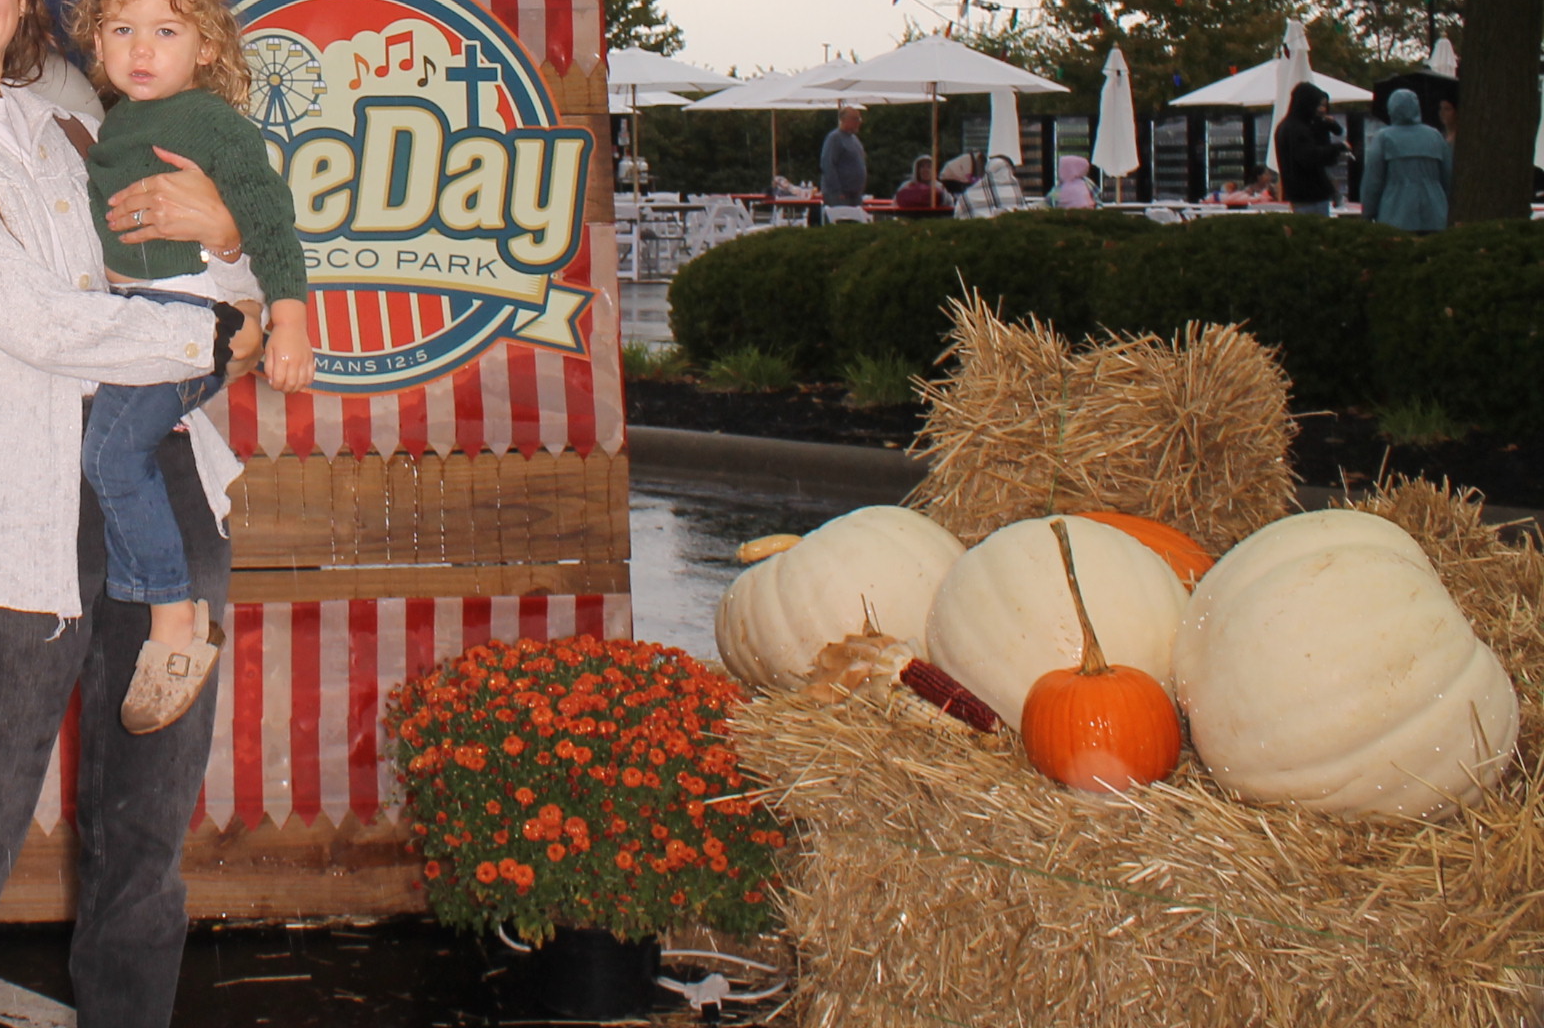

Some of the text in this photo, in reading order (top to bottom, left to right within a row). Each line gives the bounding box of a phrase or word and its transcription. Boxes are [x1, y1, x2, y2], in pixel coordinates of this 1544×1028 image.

[264, 105, 586, 266] eDay
[303, 247, 499, 279] SCO PARK
[313, 349, 428, 373] MANS 12:5
